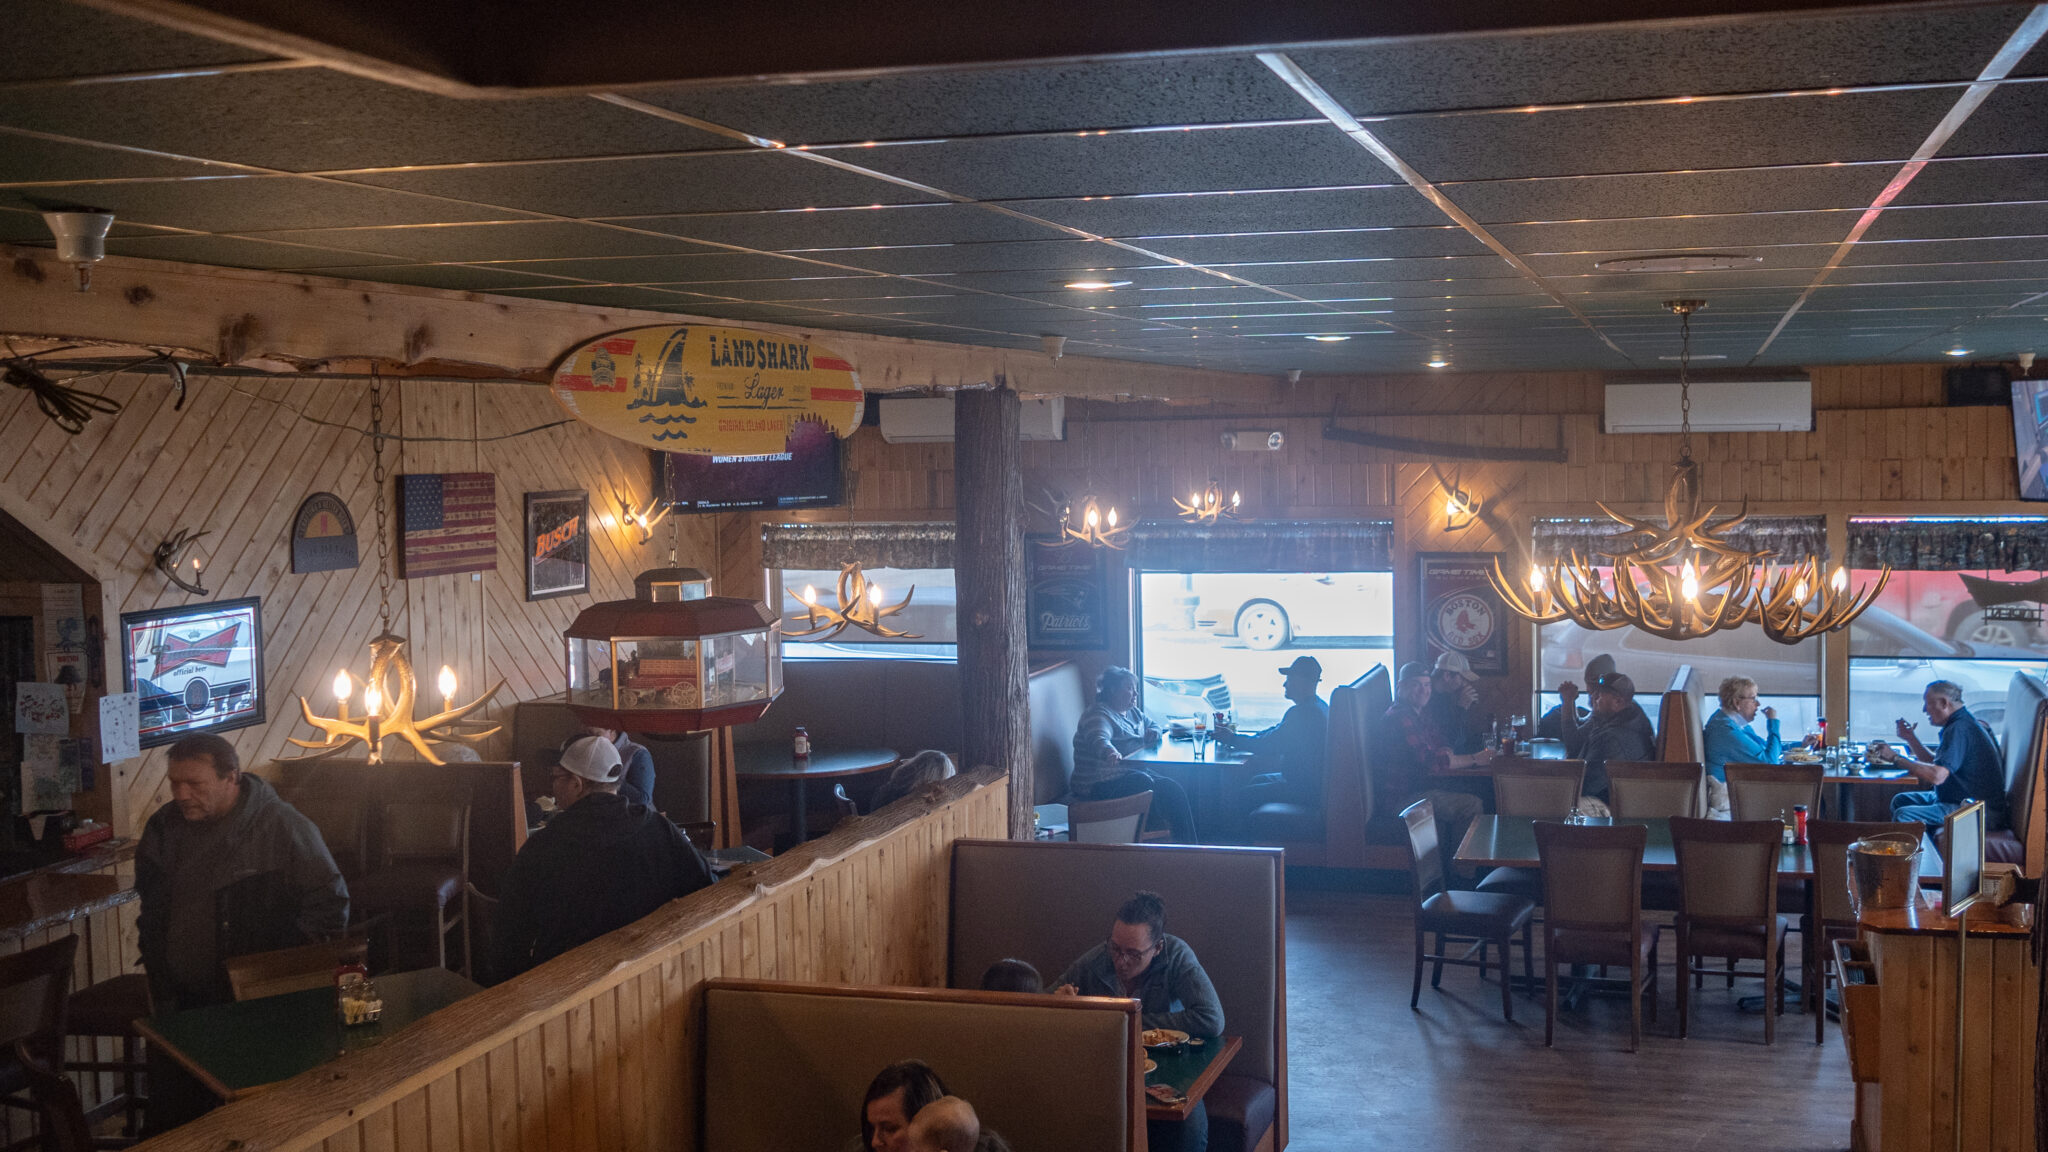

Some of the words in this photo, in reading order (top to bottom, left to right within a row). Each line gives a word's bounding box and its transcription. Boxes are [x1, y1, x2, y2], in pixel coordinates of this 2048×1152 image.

[709, 336, 810, 371] LANDSHARK
[744, 372, 785, 410] Lager
[718, 419, 745, 432] ORIGINAL
[746, 419, 766, 432] ISLAND
[535, 515, 579, 557] BUSCH
[1446, 600, 1486, 616] BOSTON
[1041, 612, 1090, 631] Patriots
[173, 667, 194, 676] official
